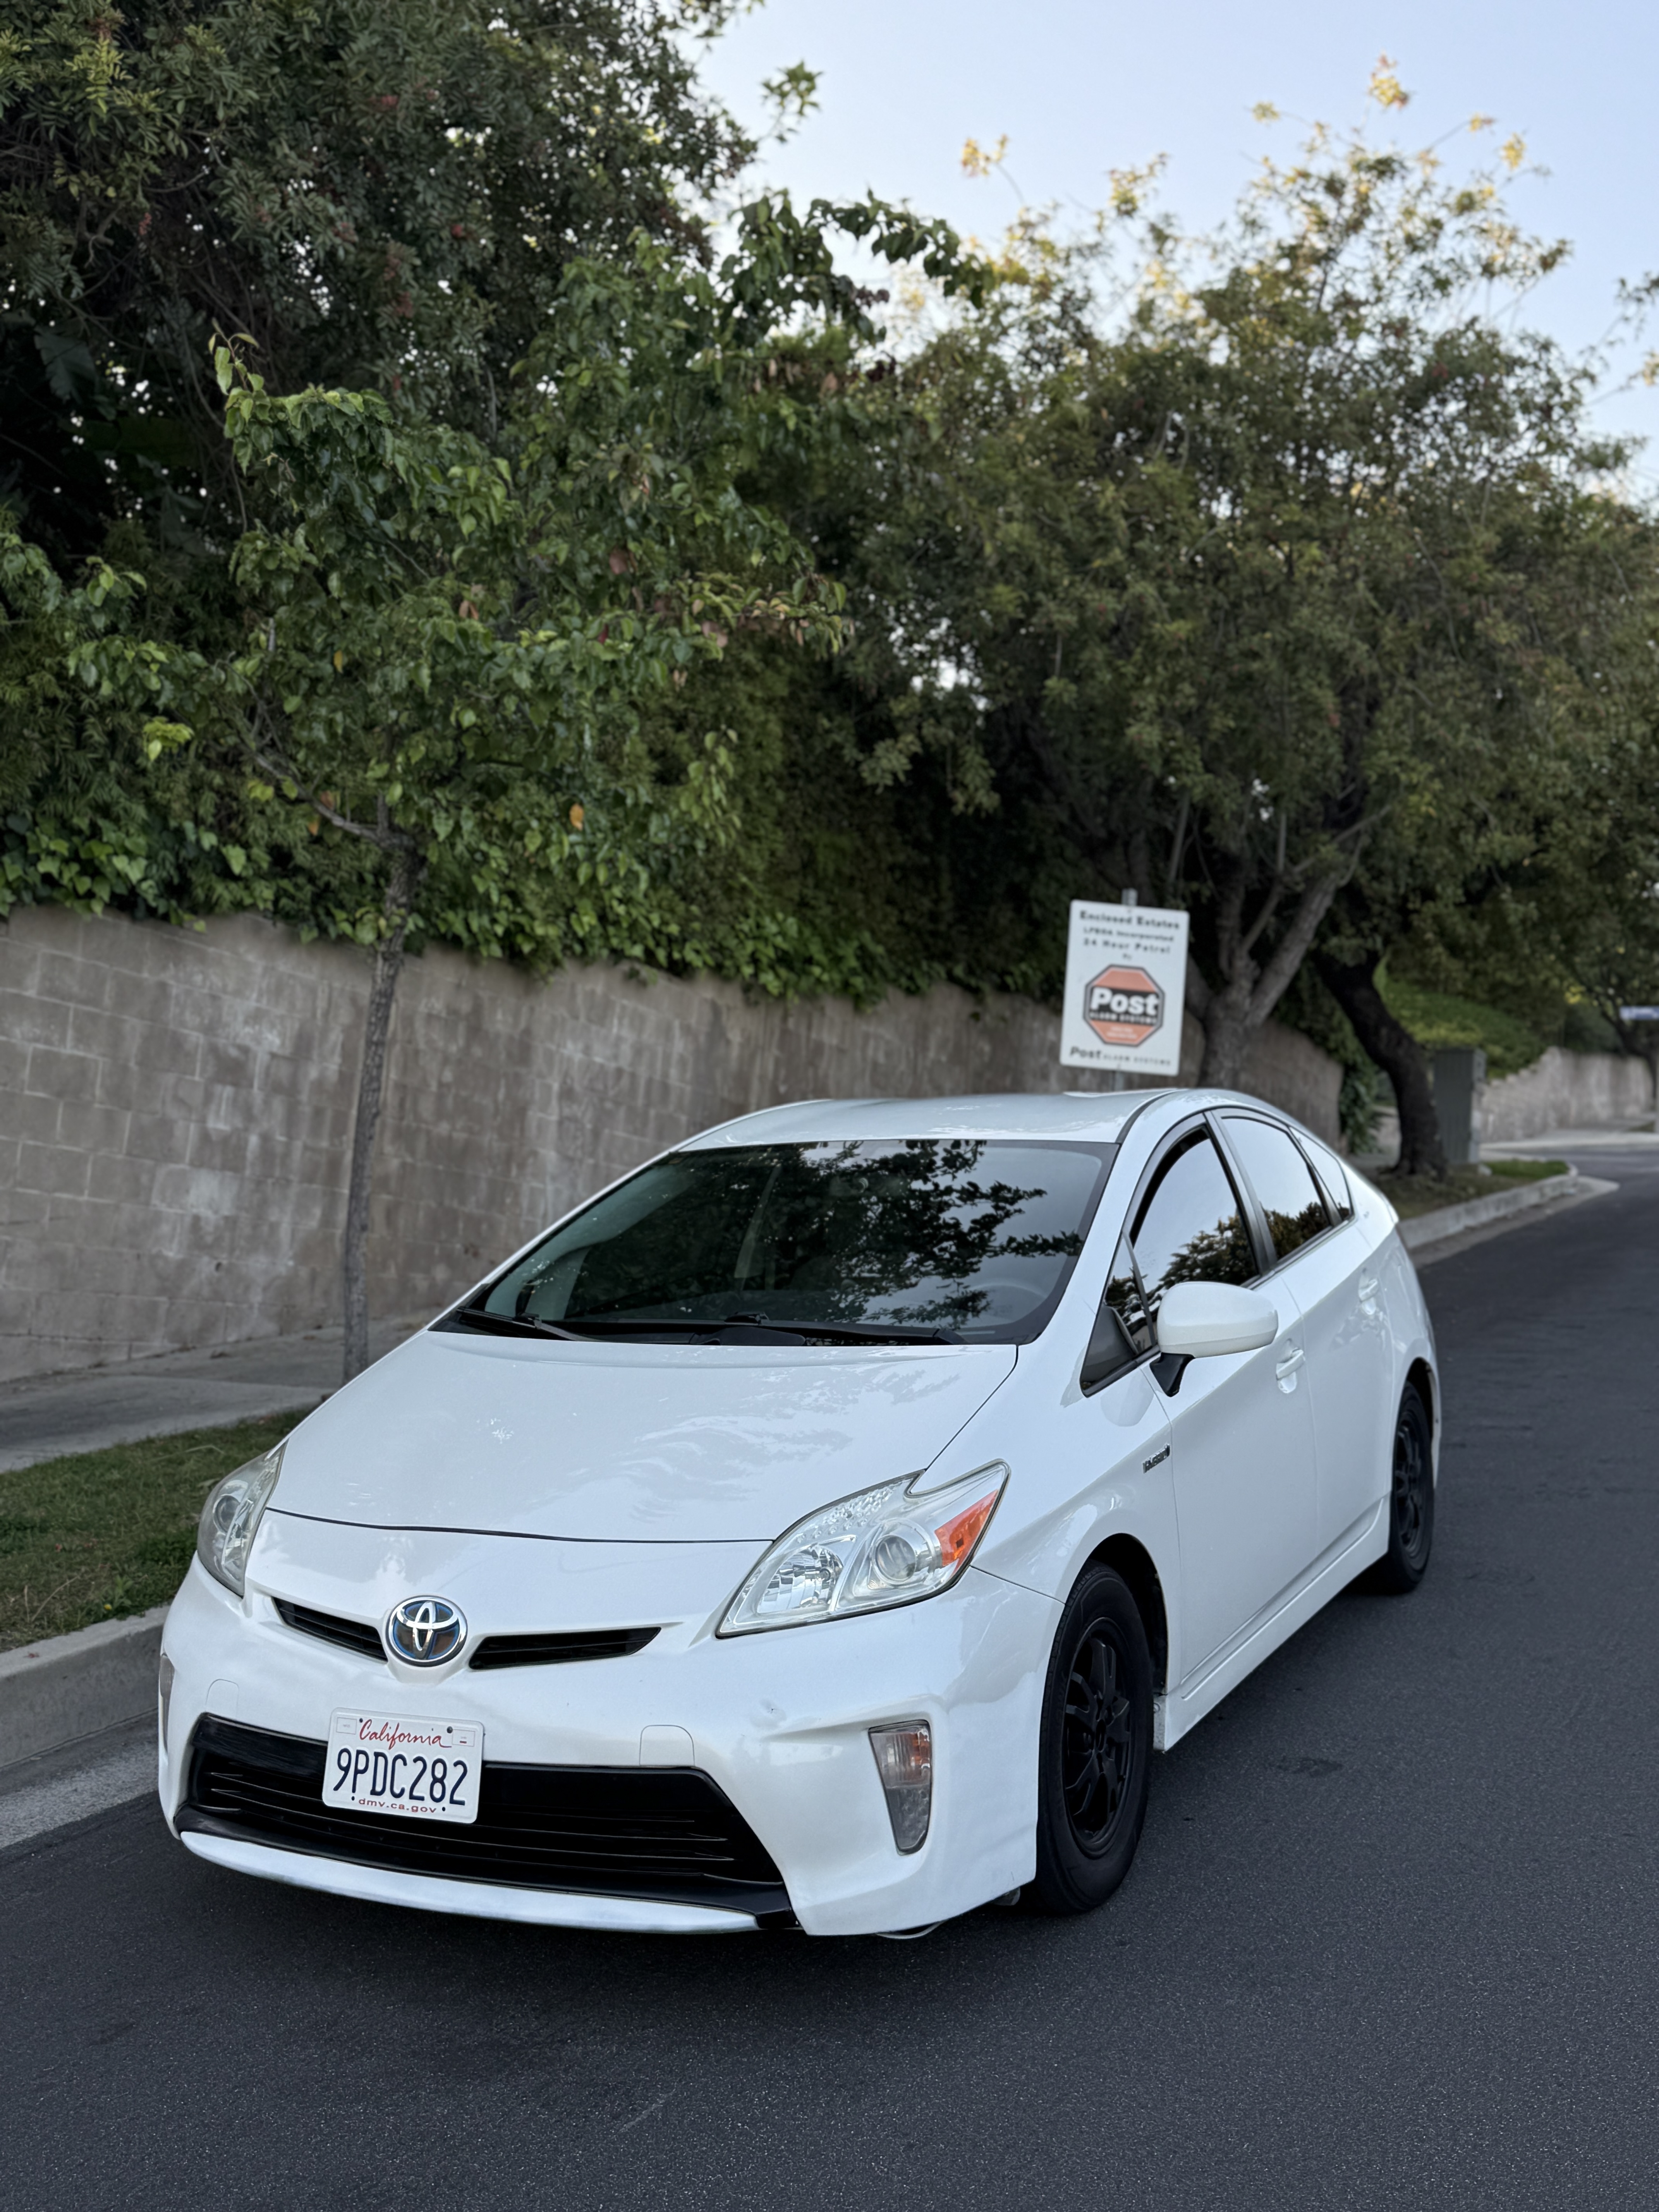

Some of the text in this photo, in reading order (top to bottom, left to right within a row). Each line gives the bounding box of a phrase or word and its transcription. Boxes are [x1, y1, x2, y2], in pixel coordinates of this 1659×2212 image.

[1080, 910, 1179, 929] Enclosed Estates
[1084, 938, 1170, 953] 24 Hour Patrol
[1090, 987, 1159, 1016] Post
[1070, 1046, 1101, 1059] Post
[359, 1719, 452, 1750] California
[333, 1747, 468, 1806] 9PDC282
[358, 1798, 437, 1813] dmv.ca.gov
